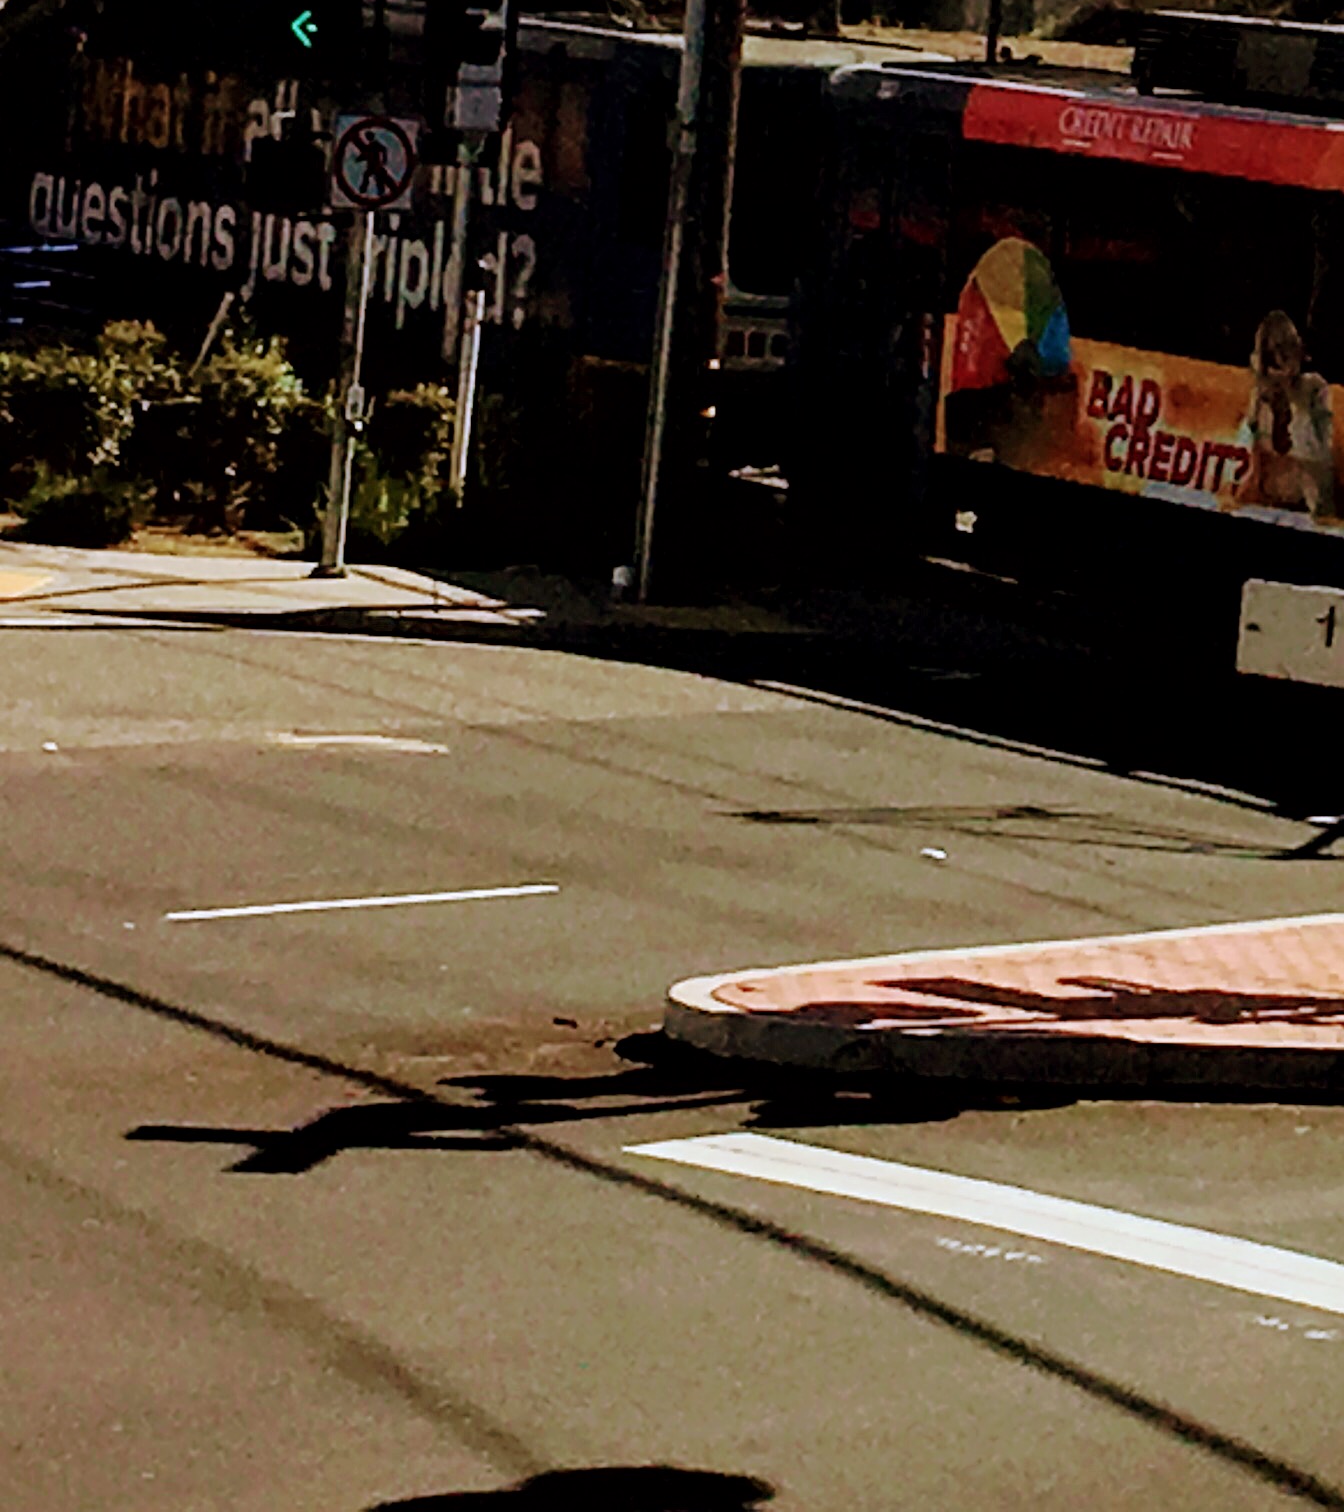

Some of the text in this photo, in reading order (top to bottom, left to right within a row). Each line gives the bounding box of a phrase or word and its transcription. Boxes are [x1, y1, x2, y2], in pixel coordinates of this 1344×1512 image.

[1058, 105, 1127, 140] CREDIT
[1130, 114, 1195, 150] REPAIR
[29, 167, 237, 273] questions
[1085, 367, 1163, 430] BAD
[1103, 422, 1253, 496] CREDIT?
